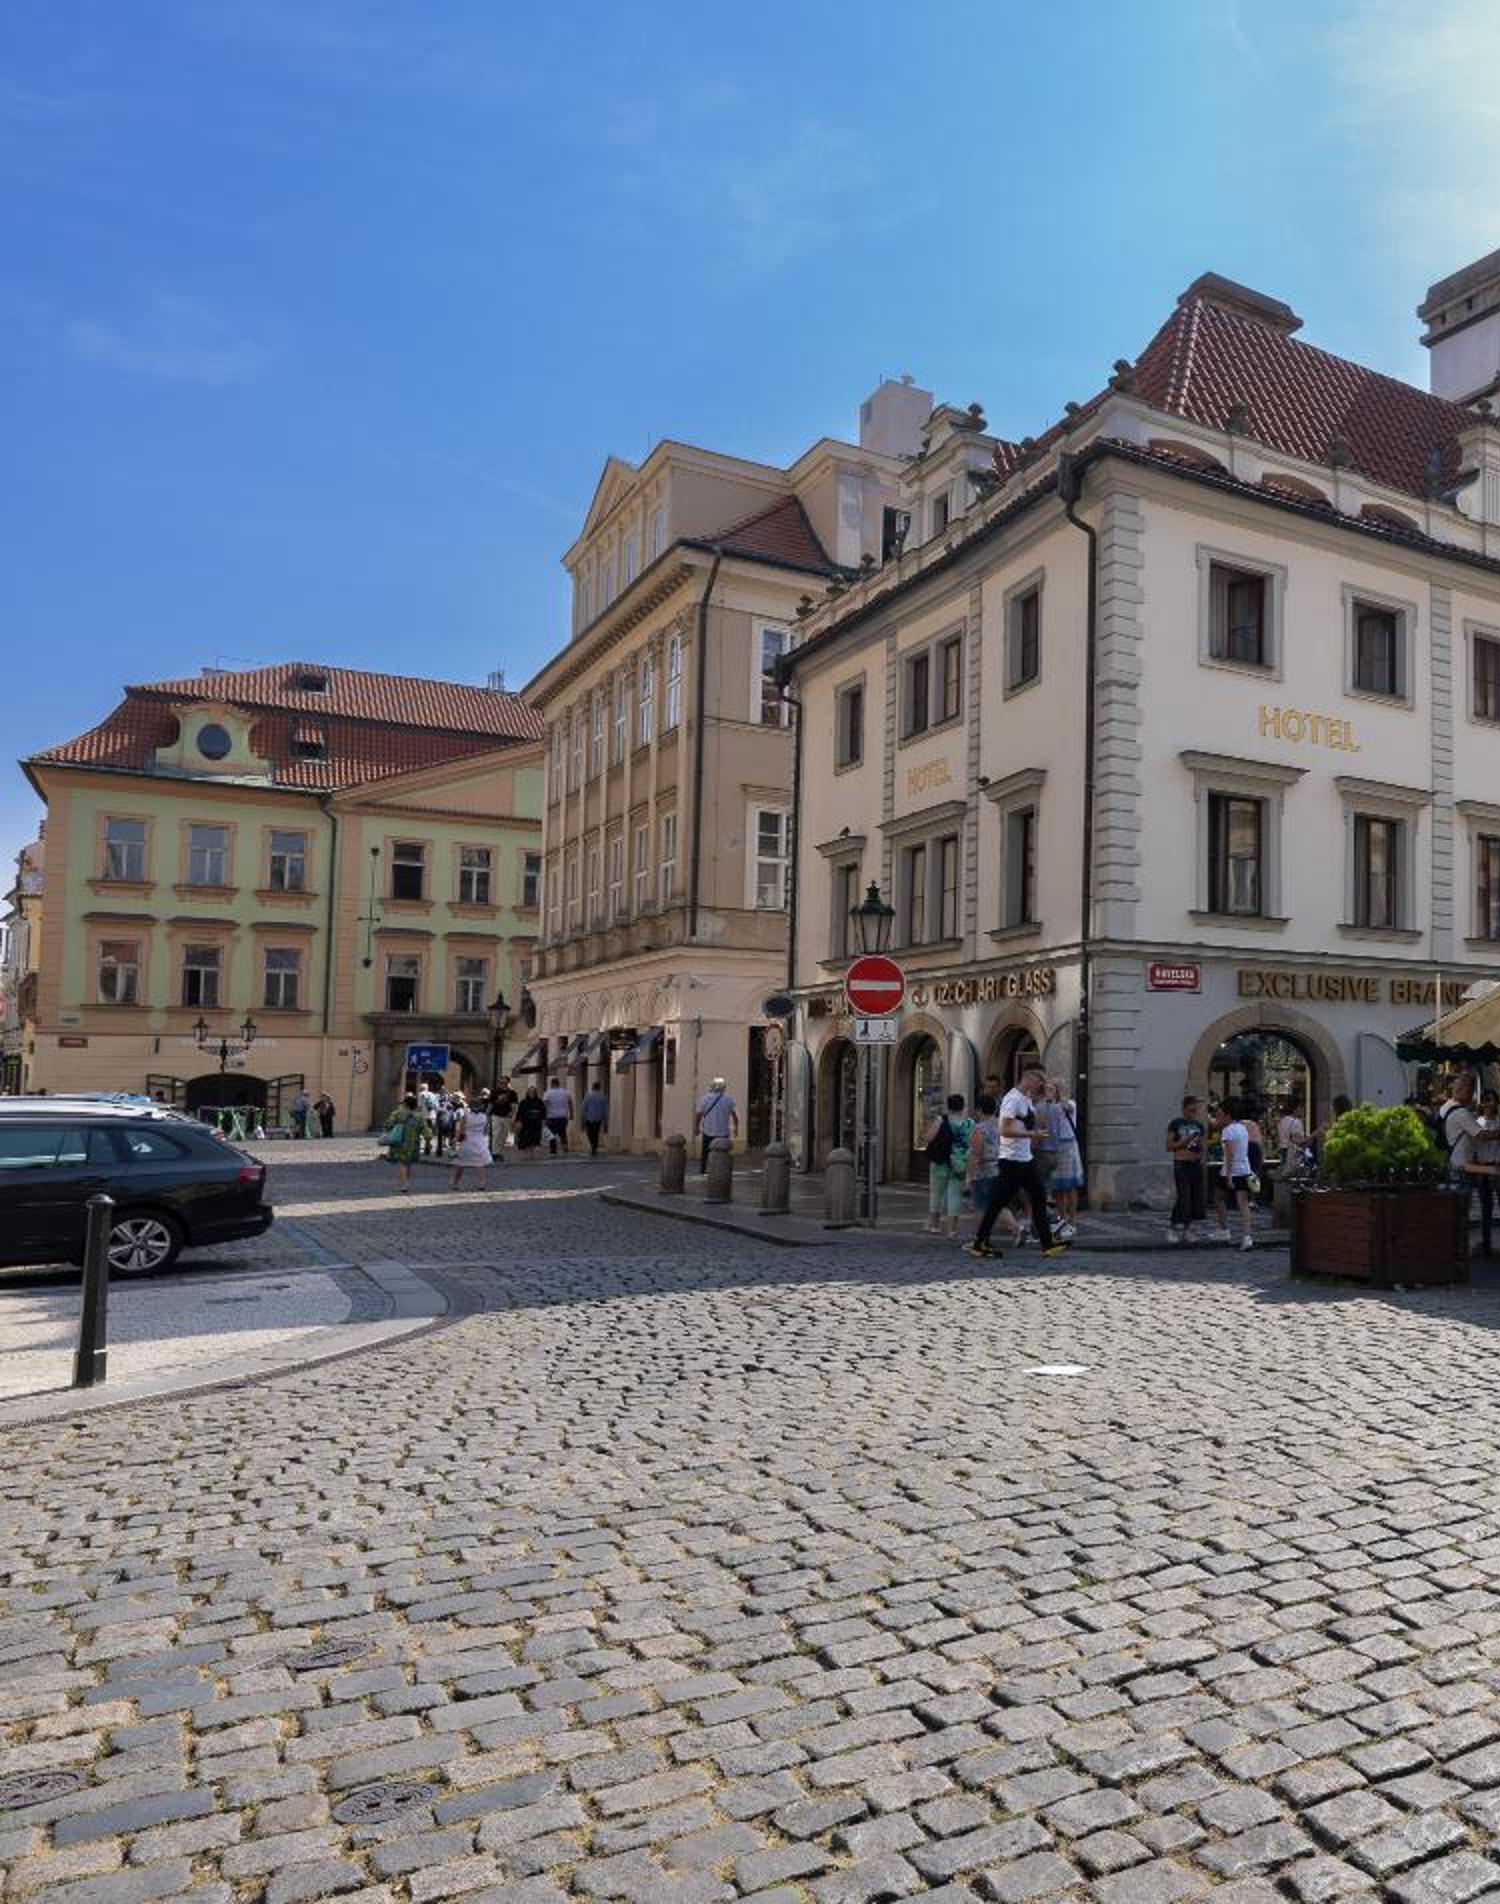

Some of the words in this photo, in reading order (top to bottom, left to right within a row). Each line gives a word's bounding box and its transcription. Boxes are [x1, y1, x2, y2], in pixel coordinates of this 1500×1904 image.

[1258, 704, 1361, 753] HOTEL
[907, 759, 952, 798] HOTEL
[1007, 968, 1055, 998] GLASS
[1237, 969, 1378, 1004] EXCLUSIVE
